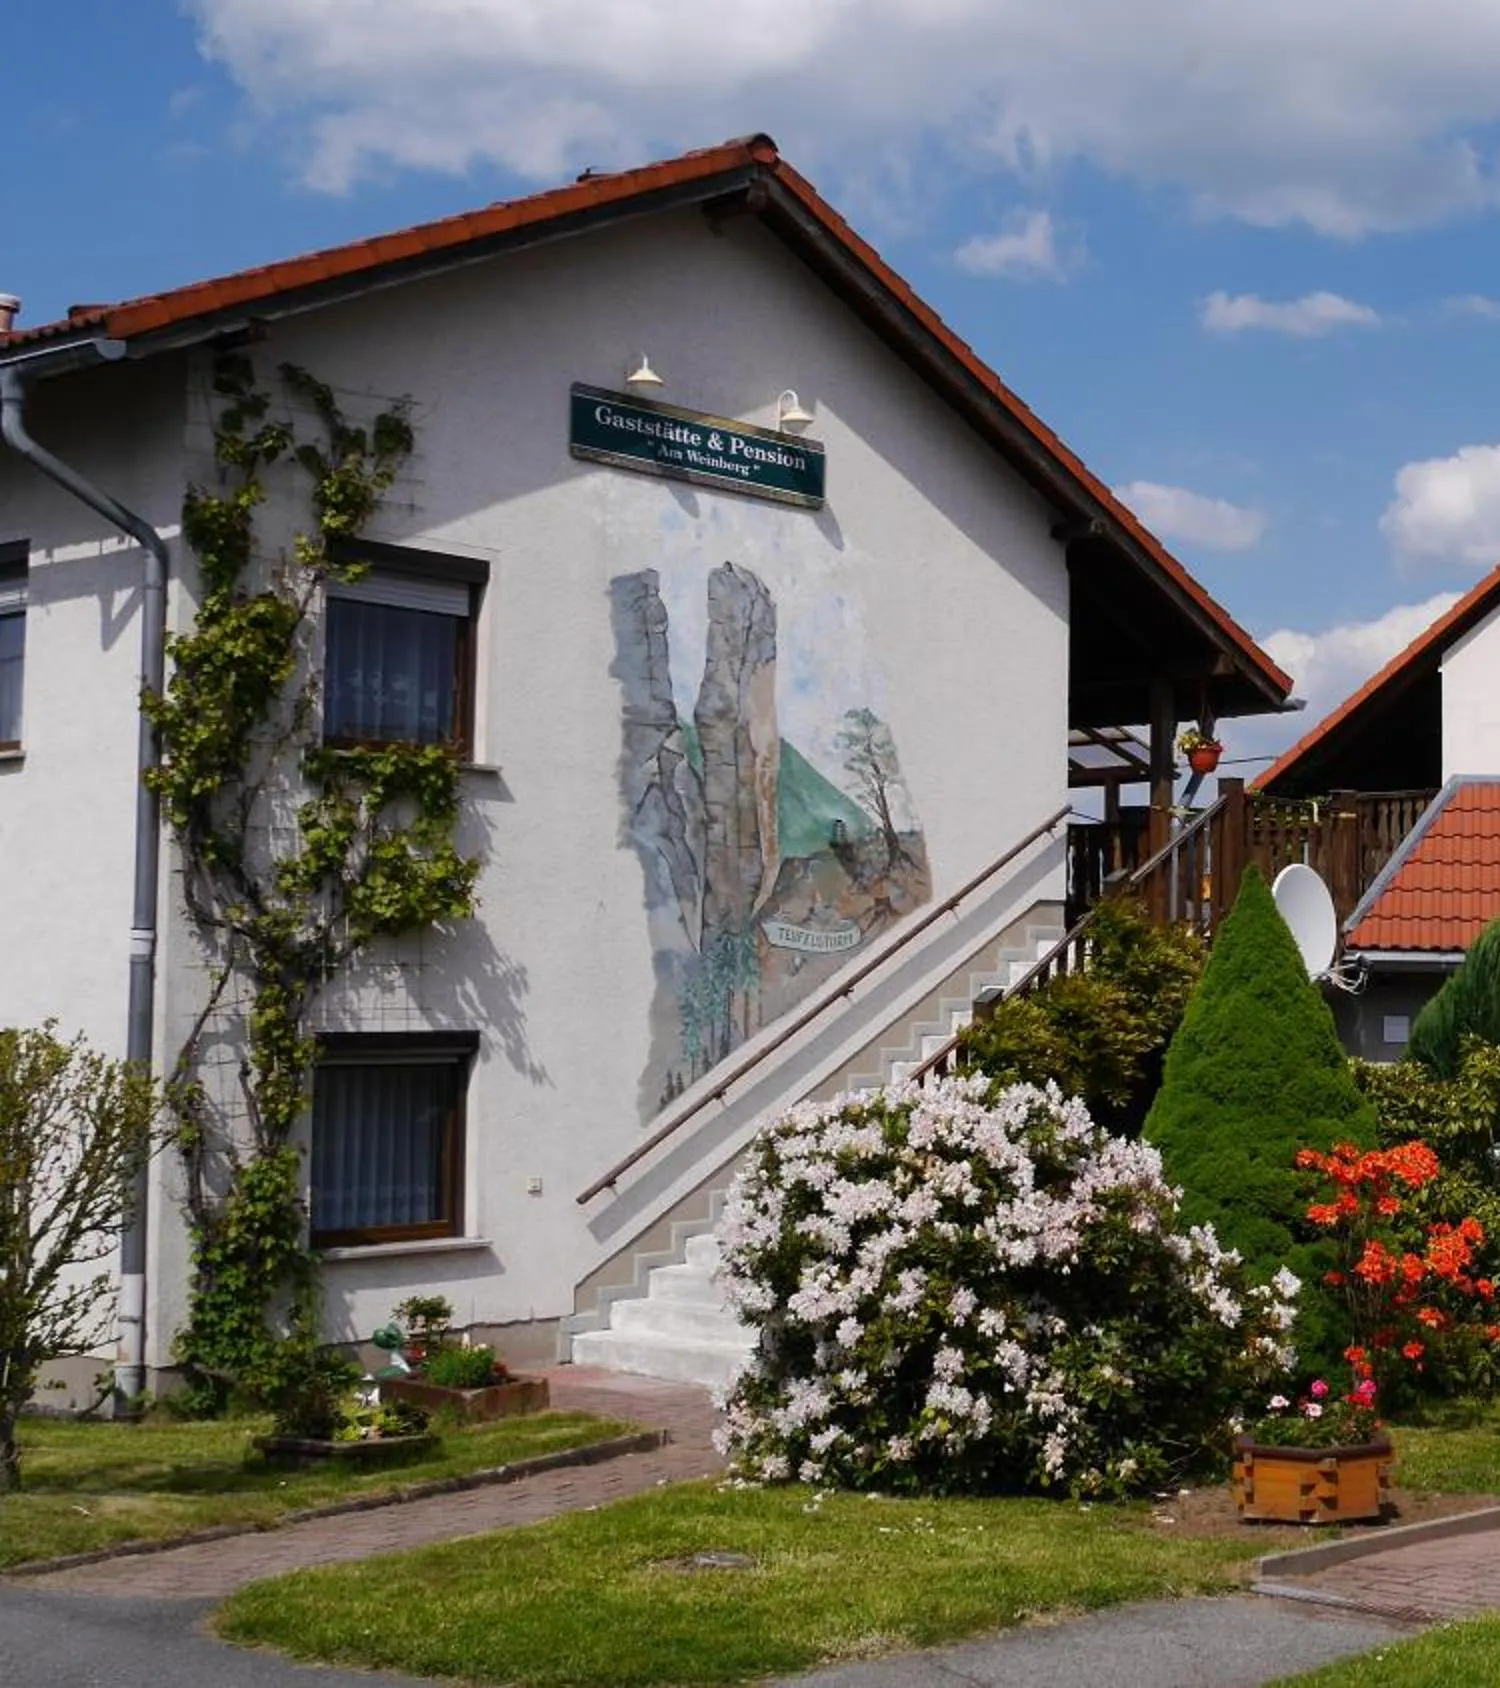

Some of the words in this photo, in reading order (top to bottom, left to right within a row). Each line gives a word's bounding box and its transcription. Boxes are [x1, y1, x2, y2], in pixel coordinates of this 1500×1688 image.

[594, 406, 701, 446] Gaststätte
[706, 432, 725, 452] &
[729, 436, 806, 471] Pension
[657, 443, 683, 461] Am
[686, 449, 751, 476] Weinberg
